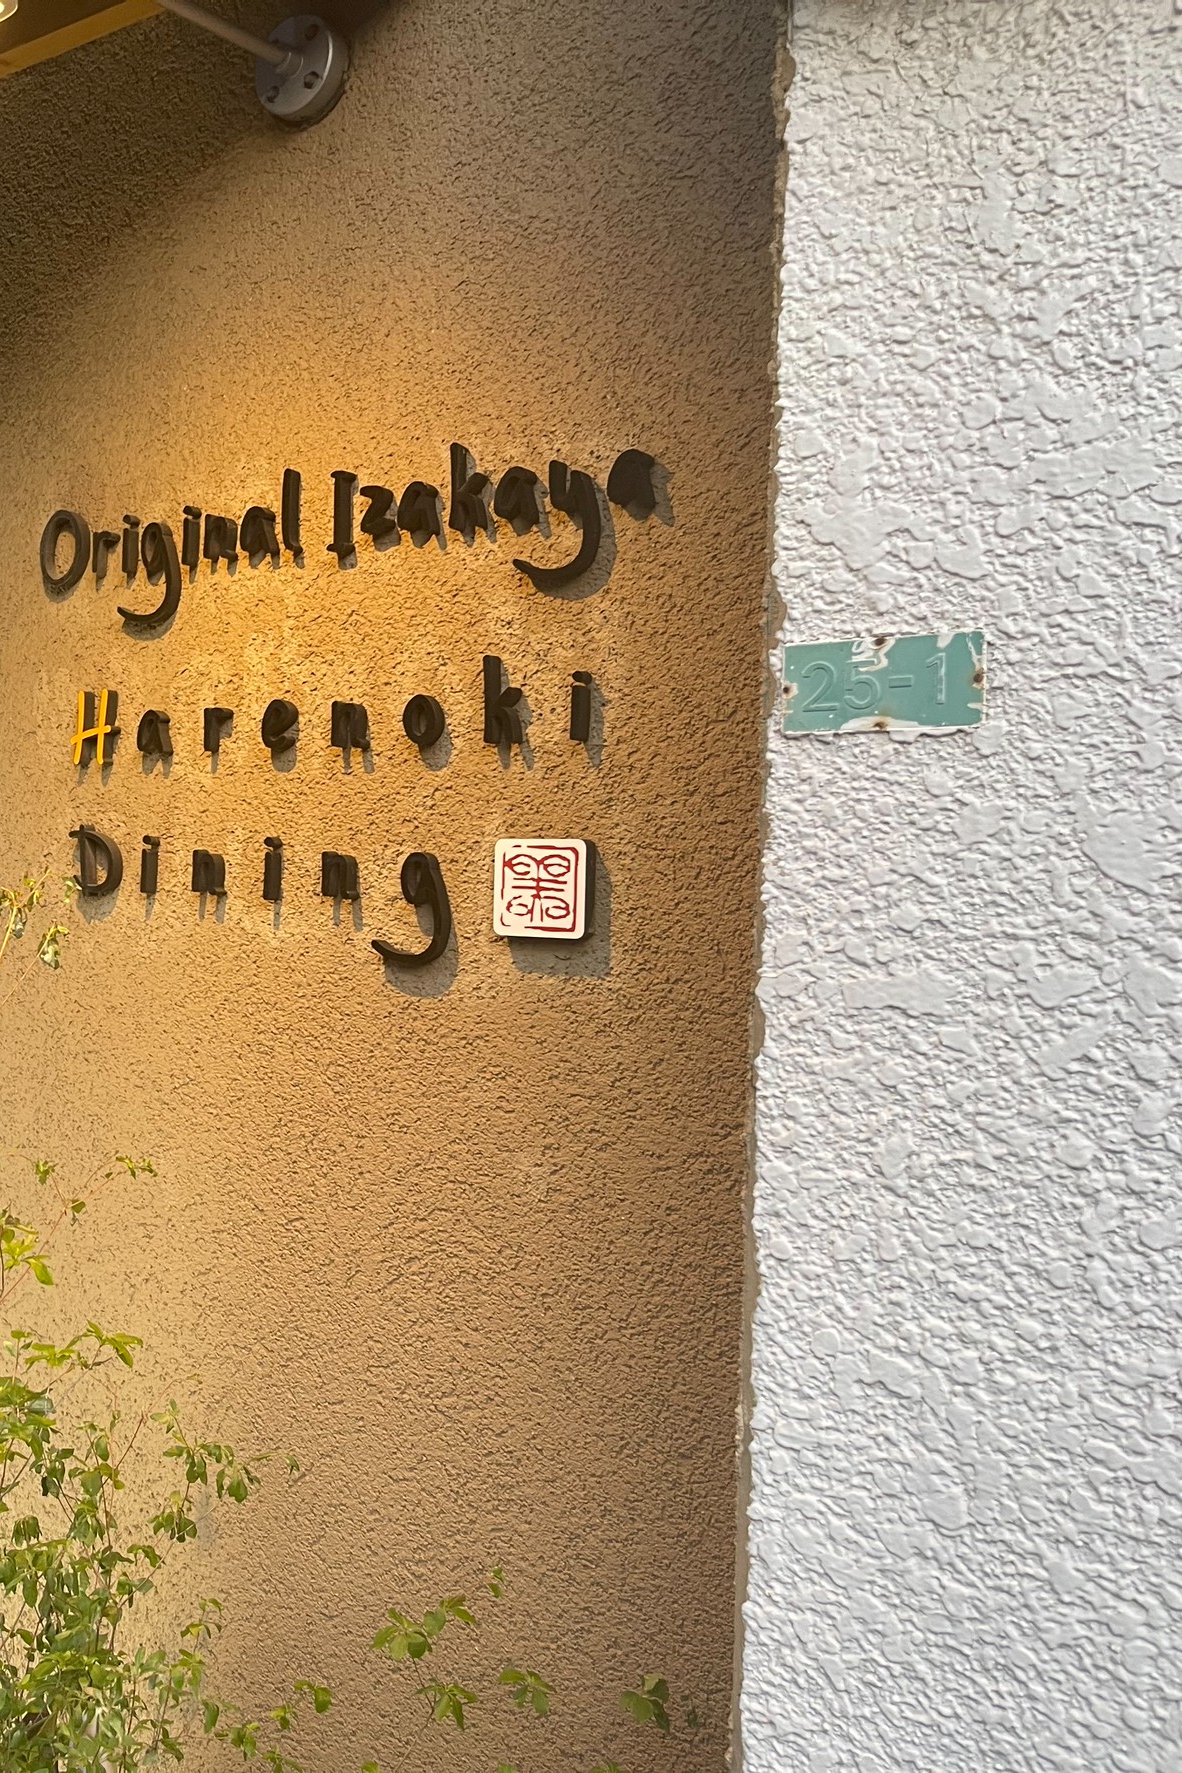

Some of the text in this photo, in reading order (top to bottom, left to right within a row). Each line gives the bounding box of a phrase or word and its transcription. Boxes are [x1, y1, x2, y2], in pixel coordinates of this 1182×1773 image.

[40, 442, 656, 624] Original Izakaya
[70, 655, 593, 766] Harenoki
[801, 651, 947, 713] 25-1
[68, 823, 452, 967] Dining
